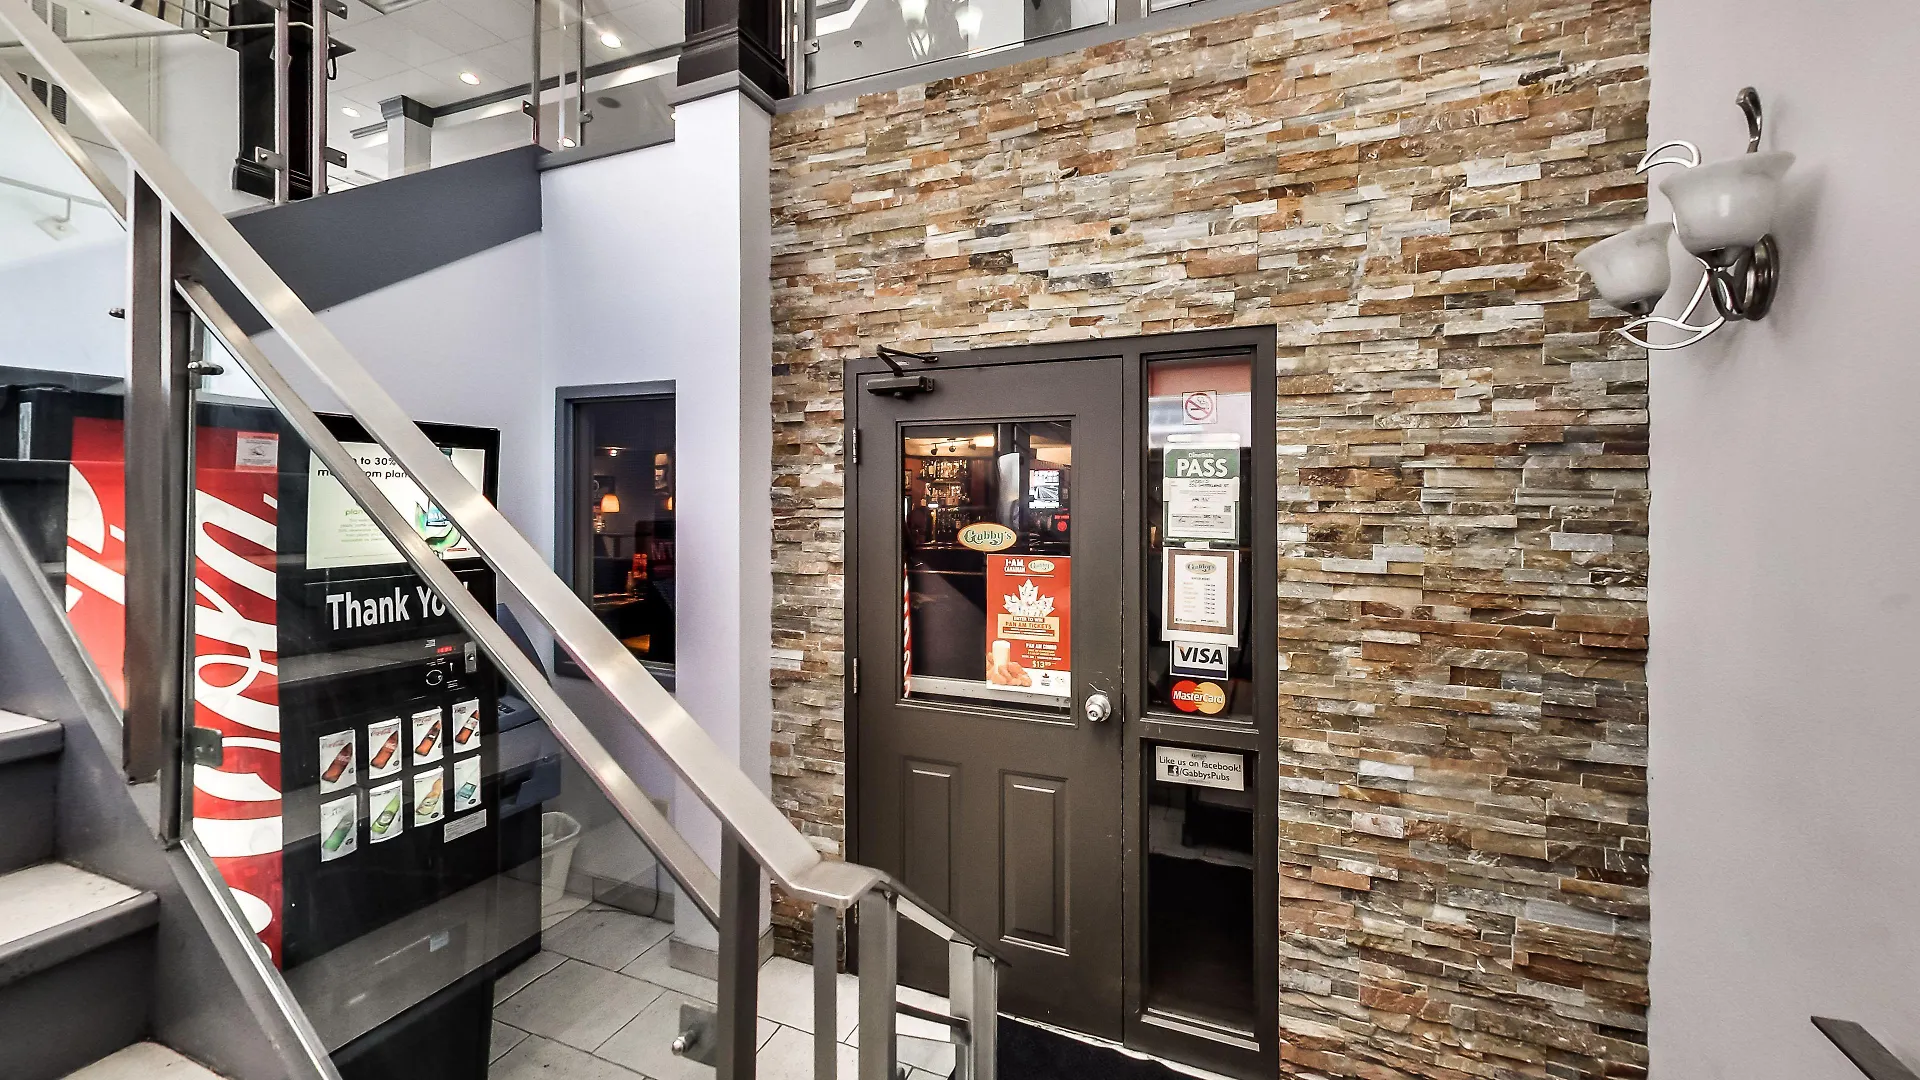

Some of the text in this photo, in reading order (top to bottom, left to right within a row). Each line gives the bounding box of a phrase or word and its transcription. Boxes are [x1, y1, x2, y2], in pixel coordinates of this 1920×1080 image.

[360, 456, 371, 465] to
[1177, 458, 1228, 478] PASS
[963, 529, 1012, 546] Gabby's
[326, 587, 410, 631] Thank
[1176, 646, 1223, 665] VISA
[1172, 690, 1224, 704] MasterCard
[1159, 756, 1175, 764] Like
[1201, 760, 1242, 773] facebook!
